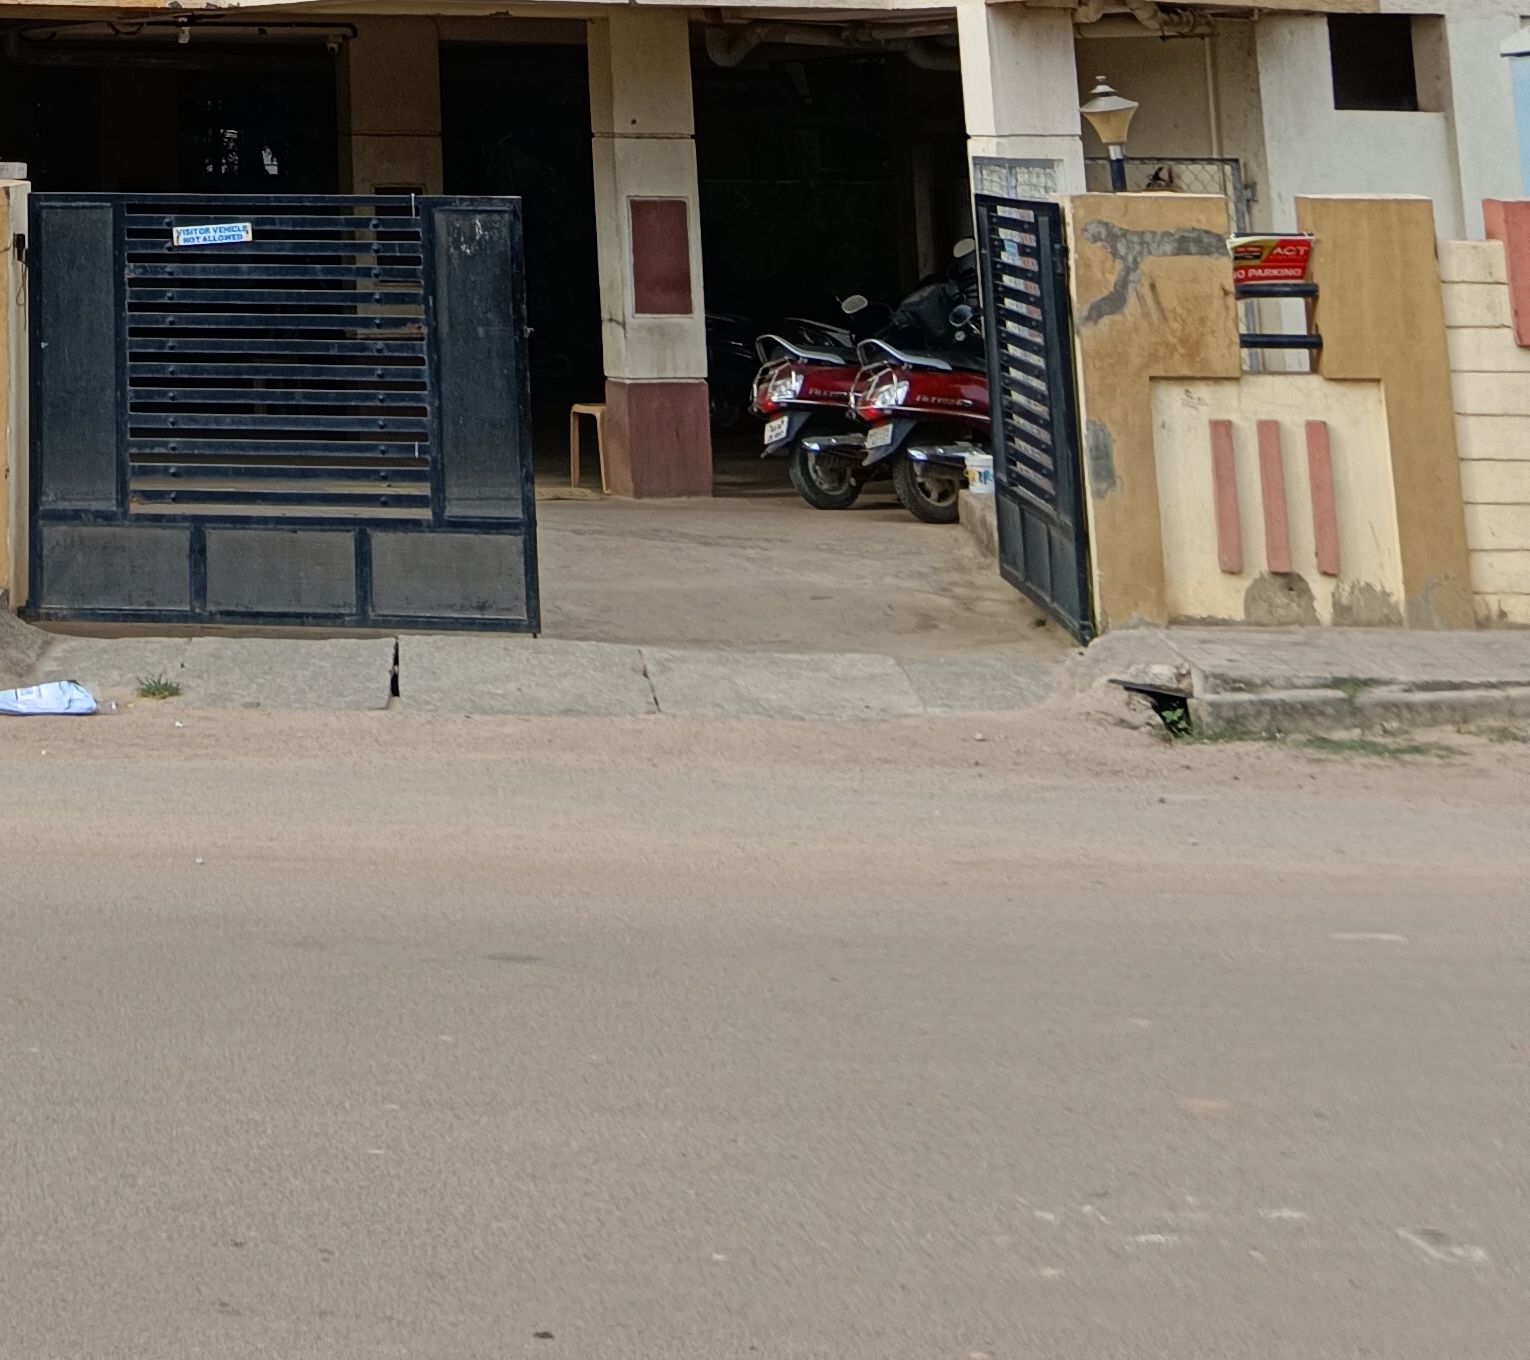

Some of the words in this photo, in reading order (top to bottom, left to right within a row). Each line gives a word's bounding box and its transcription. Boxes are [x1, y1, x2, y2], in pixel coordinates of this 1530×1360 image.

[176, 226, 210, 237] VISITOR
[212, 224, 247, 234] VEHICLE
[202, 233, 243, 243] ALLOWED
[1272, 246, 1308, 256] ACT
[1248, 268, 1302, 279] PARKING
